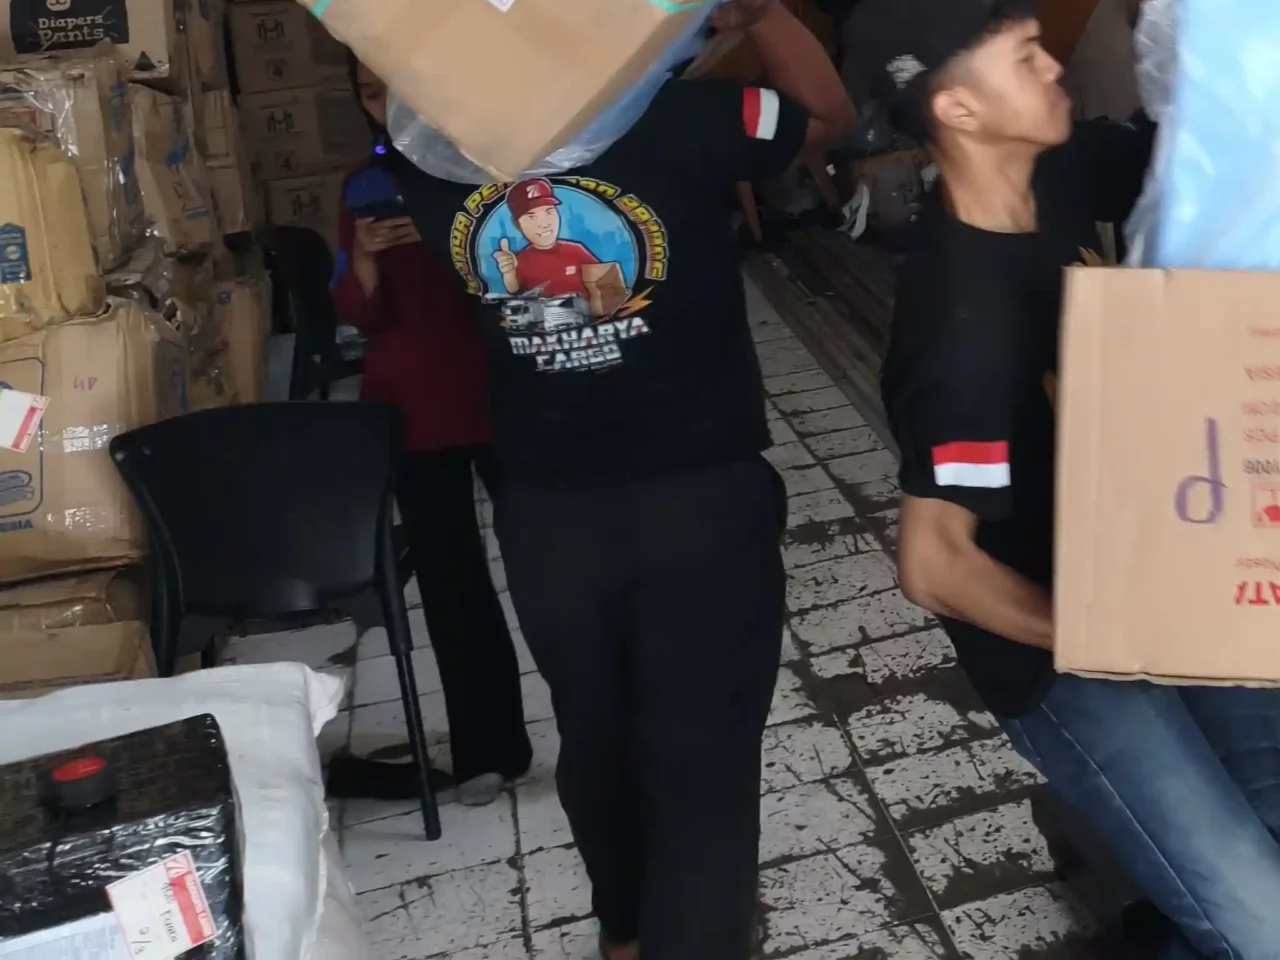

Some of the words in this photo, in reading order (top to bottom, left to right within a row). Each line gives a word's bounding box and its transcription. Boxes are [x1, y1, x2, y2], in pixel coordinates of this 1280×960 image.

[38, 15, 103, 29] Diapers
[38, 26, 104, 44] Pants
[508, 316, 649, 354] MAKHARYA
[535, 343, 622, 370] CARGO
